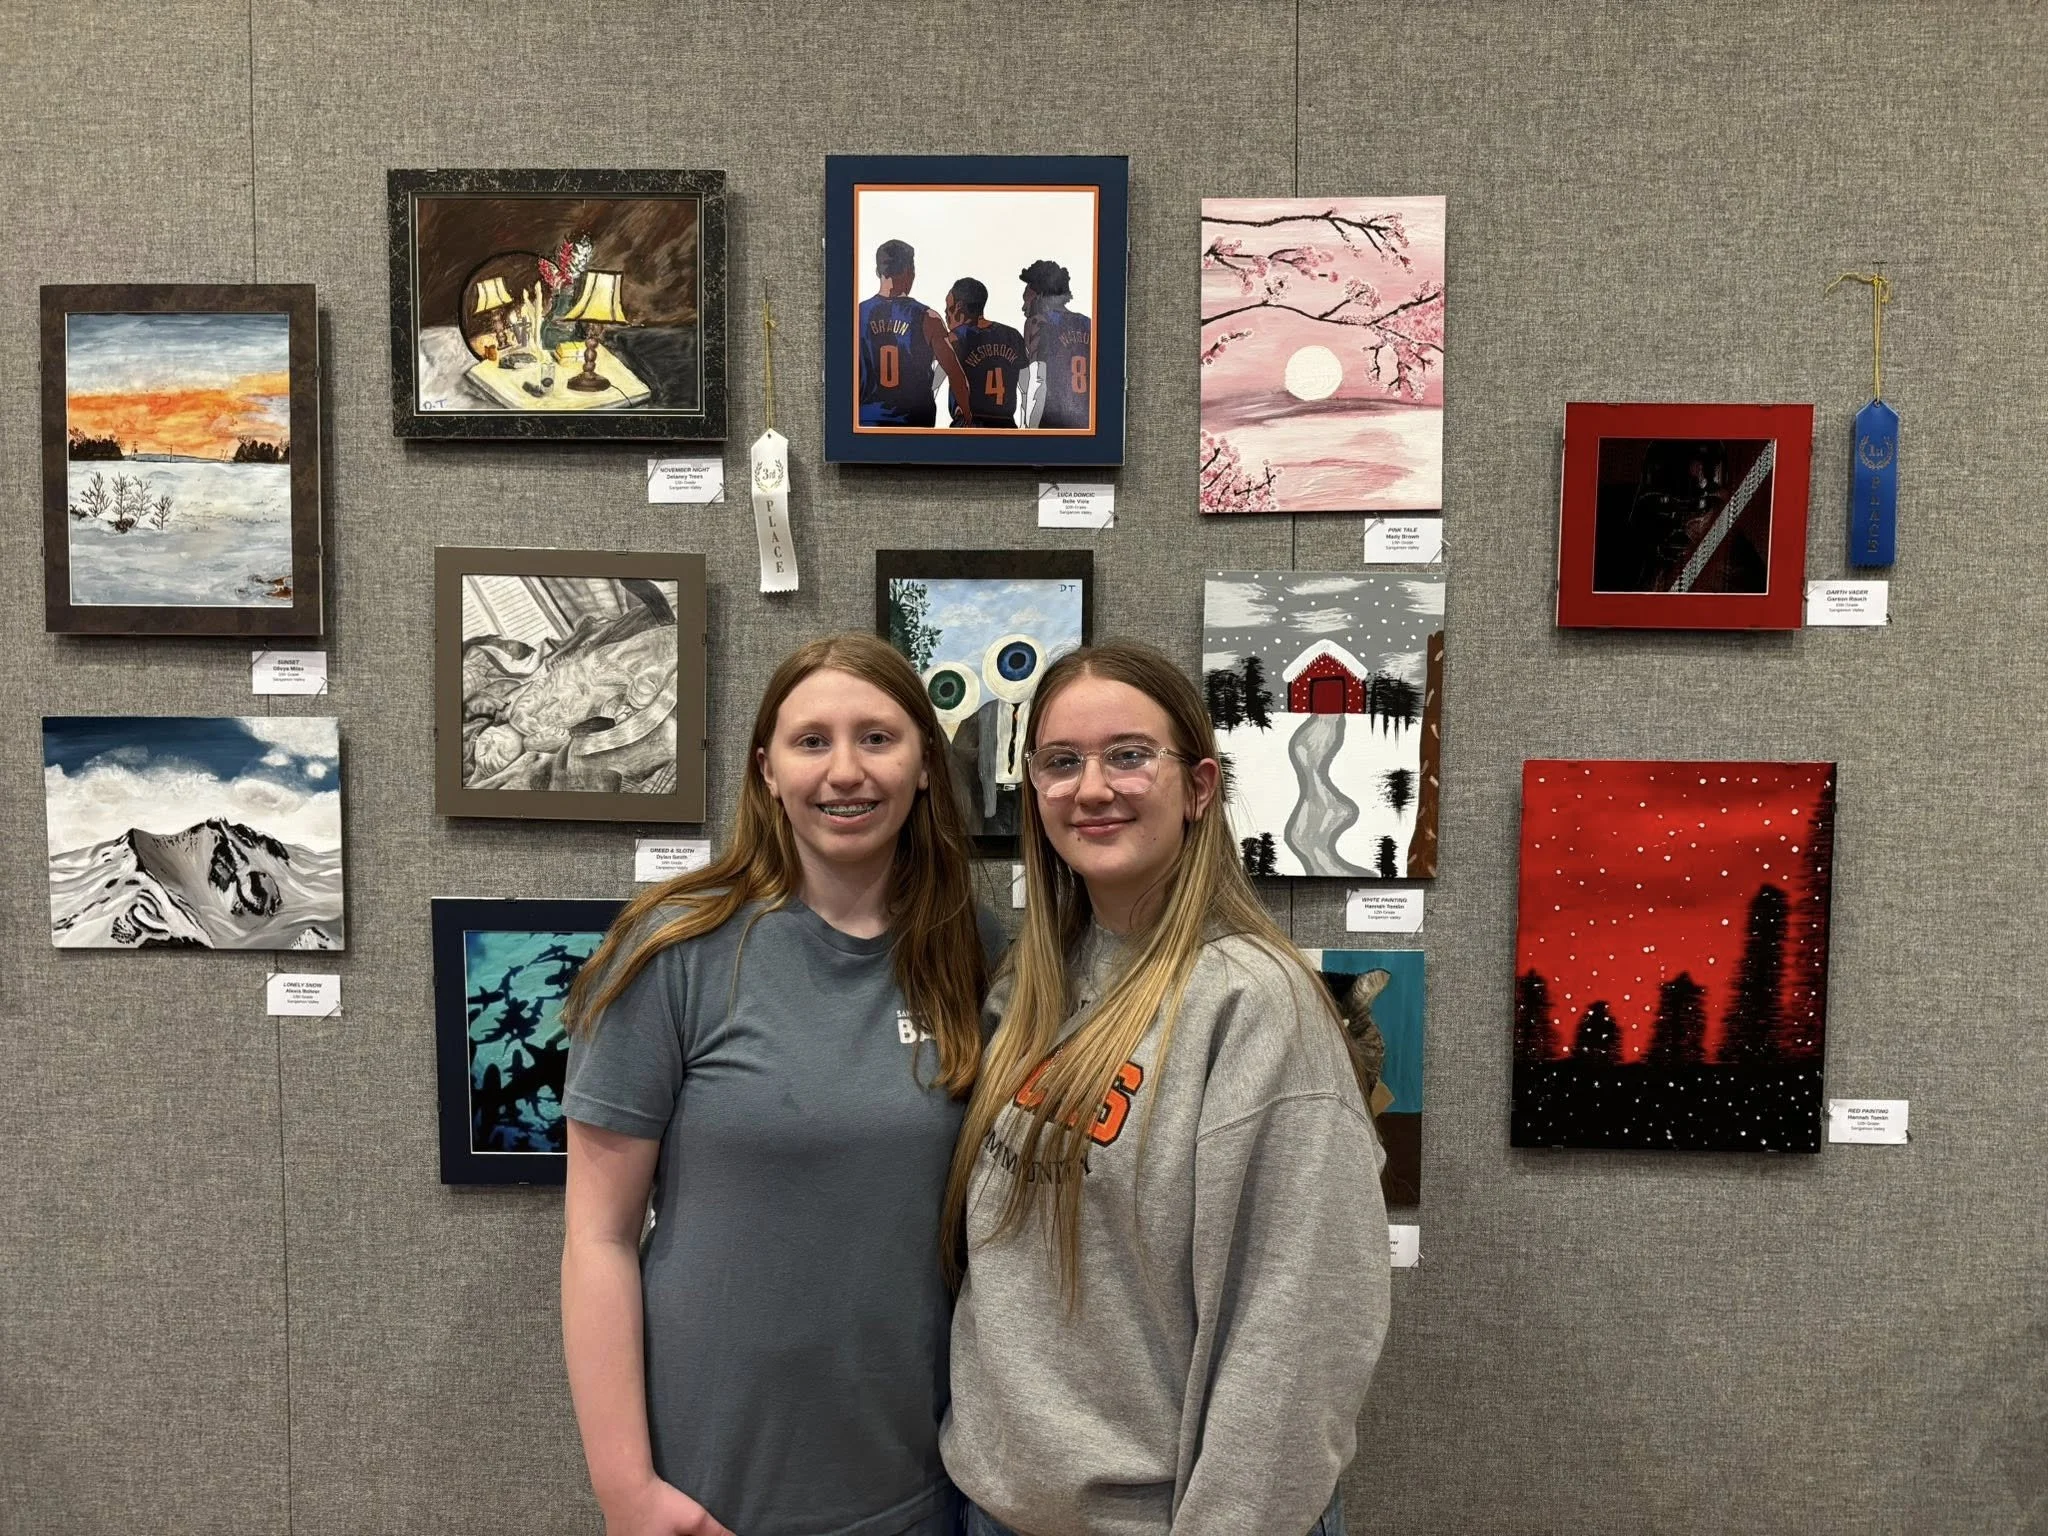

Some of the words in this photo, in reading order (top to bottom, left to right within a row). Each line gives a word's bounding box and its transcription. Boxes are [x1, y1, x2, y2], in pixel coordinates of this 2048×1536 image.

[870, 319, 911, 336] BRAUN
[880, 344, 900, 388] 0
[1071, 355, 1088, 394] 8
[985, 367, 1006, 406] 4
[762, 468, 776, 481] 3rd
[766, 500, 785, 574] PLACE
